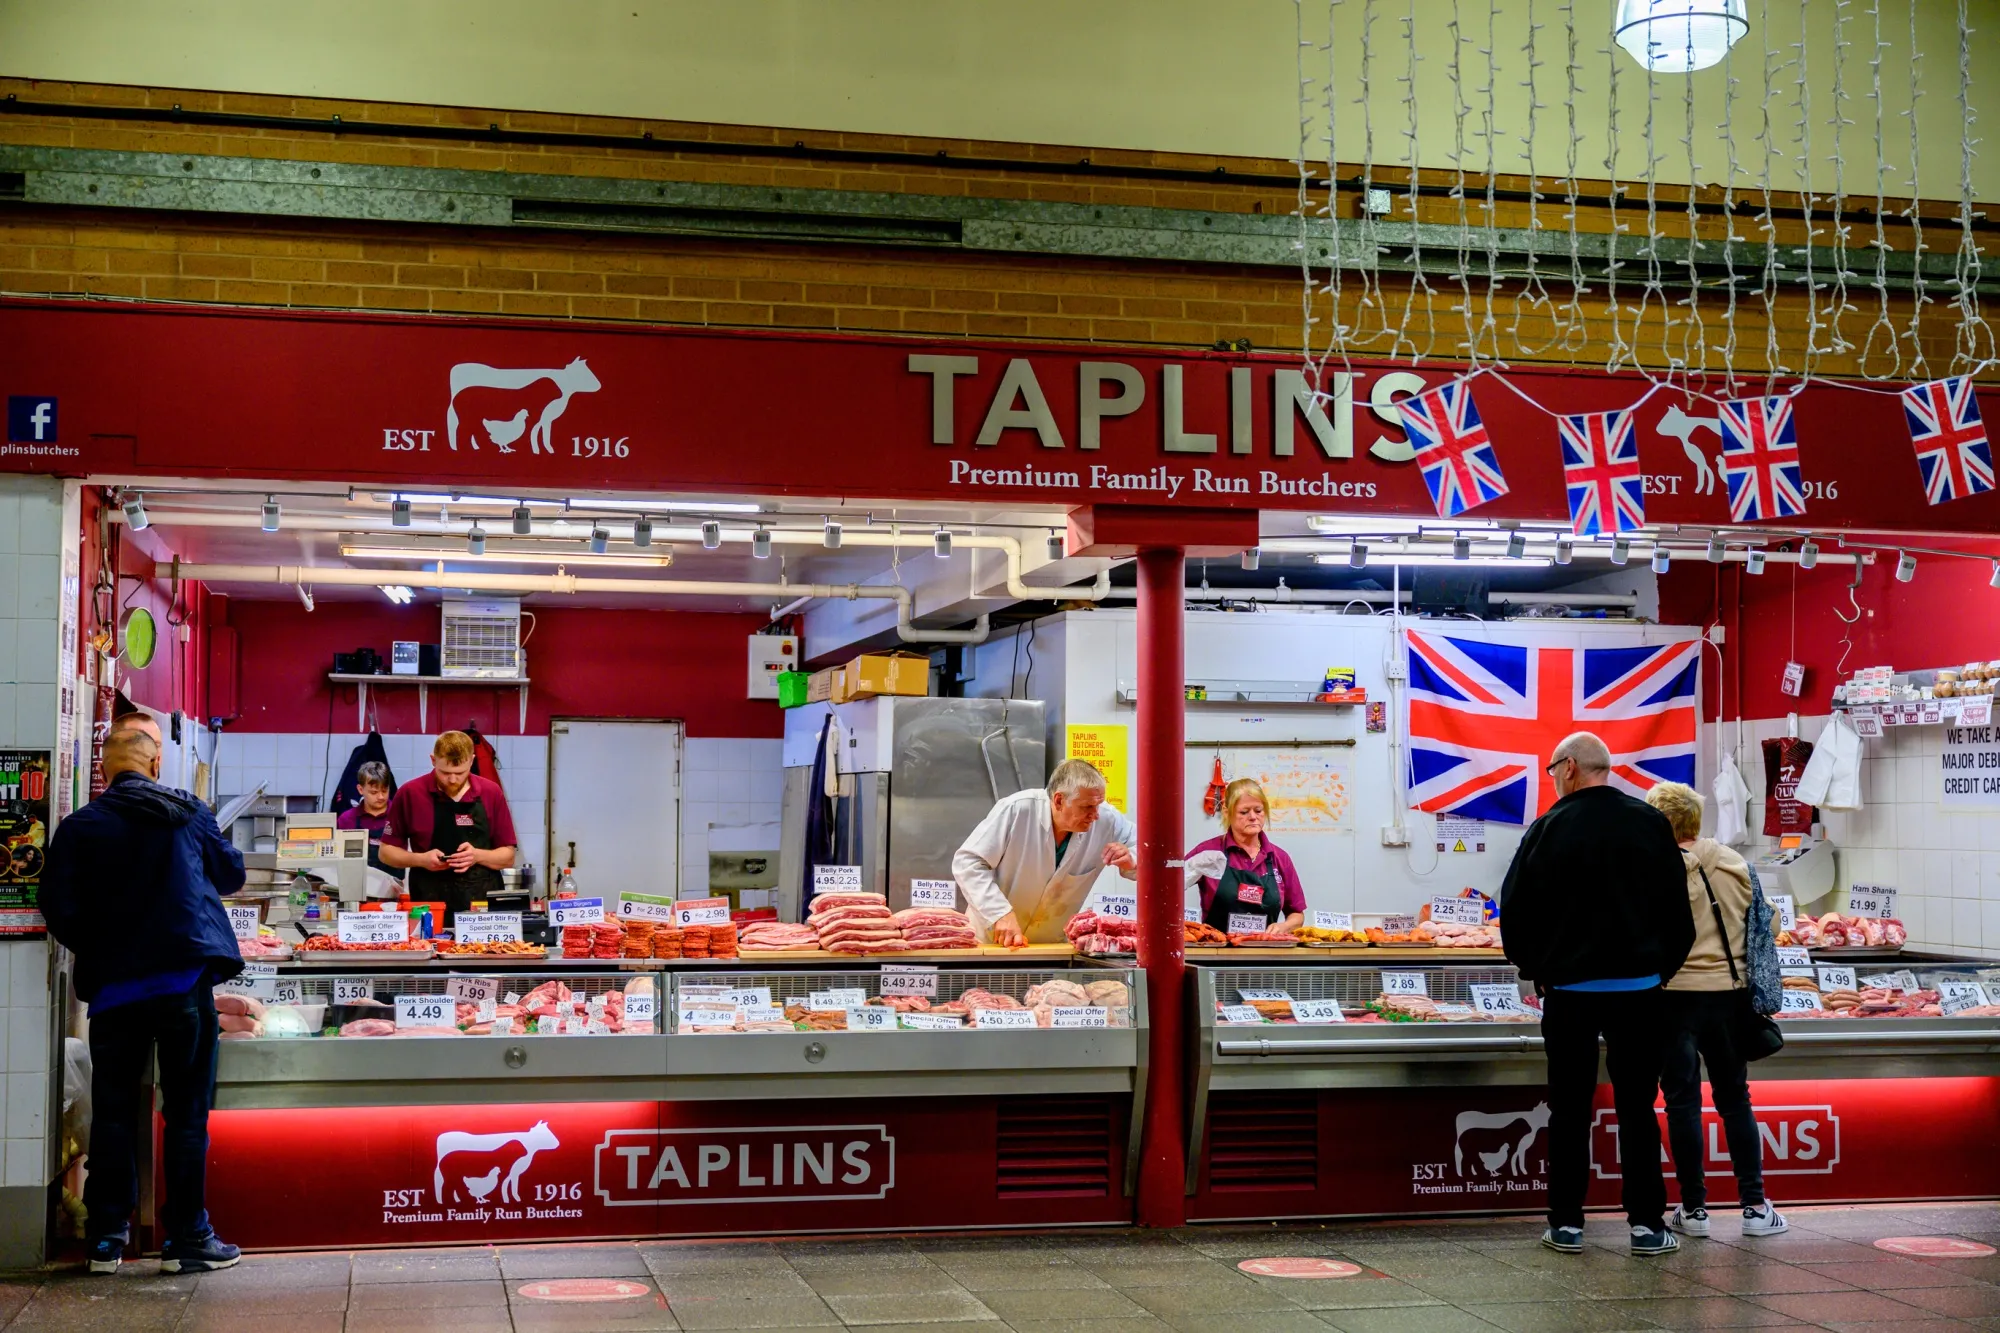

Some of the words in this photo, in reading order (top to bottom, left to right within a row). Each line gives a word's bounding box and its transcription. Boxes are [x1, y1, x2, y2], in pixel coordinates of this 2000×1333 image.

[908, 354, 1427, 461] TAPLINS
[382, 428, 435, 452] EST
[571, 436, 630, 458] 1916
[950, 460, 1080, 489] Premium
[1090, 465, 1185, 498] Family
[1193, 469, 1250, 493] Run
[1259, 470, 1377, 498] Butchers
[1640, 476, 1682, 494] EST
[1803, 481, 1838, 500] 916
[1947, 728, 1962, 744] WE
[1966, 727, 1990, 744] TAKE
[4, 762, 20, 772] GOT
[1942, 753, 1974, 769] MAJOR
[20, 771, 44, 800] 10
[1944, 778, 1979, 794] CREDIT
[816, 876, 835, 884] 4.95
[838, 876, 858, 884] 2.25
[912, 890, 931, 898] 4.95
[934, 891, 952, 900] 2.25
[1852, 884, 1870, 892] Ham
[1872, 886, 1896, 894] Shanks
[1850, 900, 1876, 910] £1.99
[1885, 896, 1890, 904] 3
[232, 909, 255, 917] Ribs
[624, 902, 632, 914] 6
[647, 907, 667, 916] 2.99
[1103, 904, 1128, 915] 4.99
[1434, 904, 1454, 914] 2.25
[1881, 910, 1891, 918] £5
[556, 910, 564, 922] 6
[580, 909, 600, 918] 2.99
[682, 911, 690, 922] 6
[706, 909, 725, 919] 2.99
[371, 933, 400, 941] £3.89
[487, 934, 515, 942] £6.29
[475, 979, 491, 987] Ribs
[882, 978, 906, 987] 6.49
[909, 978, 932, 988] 2.94
[1391, 979, 1414, 989] 2.89
[1825, 973, 1850, 986] 4.99
[338, 986, 367, 998] 3.50
[458, 985, 485, 1000] 1.99
[1784, 997, 1814, 1009] 3.99
[1941, 996, 1960, 1007] Special
[407, 1006, 442, 1018] 4.49
[626, 1004, 651, 1013] 5.49
[1300, 1008, 1334, 1018] 3.49
[685, 1011, 693, 1021] 4
[710, 1012, 731, 1020] 3.49
[616, 1141, 872, 1190] TAPLINS
[1412, 1164, 1448, 1180] EST
[534, 1182, 582, 1201] 1916
[1412, 1182, 1464, 1195] Premium
[1466, 1180, 1504, 1195] Family
[1506, 1180, 1530, 1192] Run
[383, 1188, 424, 1208] EST
[383, 1210, 443, 1224] Premium
[447, 1207, 492, 1224] Family
[495, 1207, 522, 1220] Run
[525, 1205, 582, 1220] Butchers
